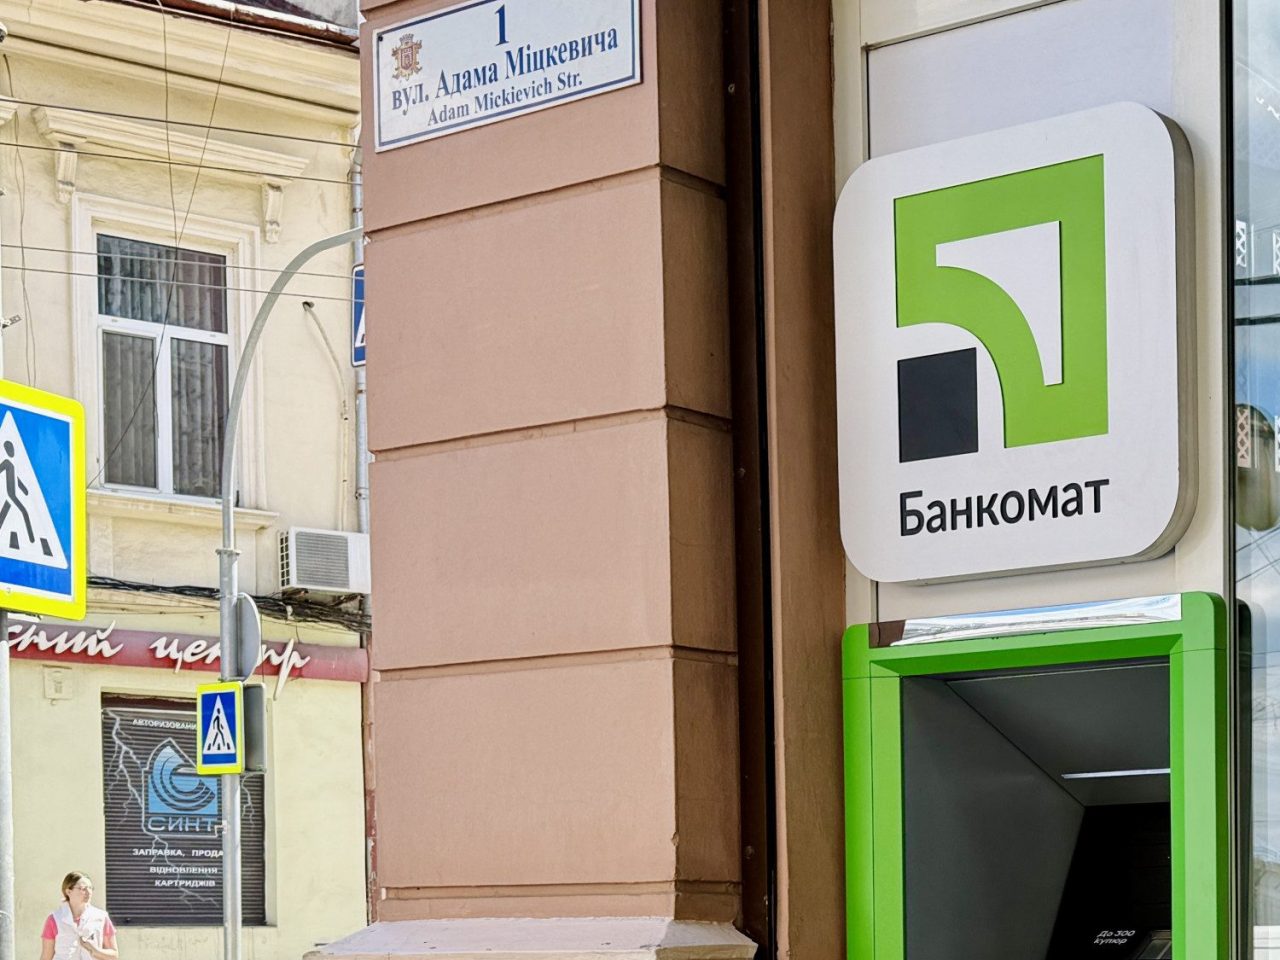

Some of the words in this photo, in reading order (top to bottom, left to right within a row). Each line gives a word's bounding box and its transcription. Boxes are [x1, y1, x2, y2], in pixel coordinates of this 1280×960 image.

[495, 4, 509, 46] 1
[392, 84, 430, 116] вул.
[435, 62, 499, 98] Адама
[505, 27, 618, 80] Міцкевича
[427, 103, 470, 126] Adam
[474, 80, 552, 114] Mickievich
[557, 71, 583, 91] Str.
[900, 479, 1110, 536] Банкомат
[191, 849, 224, 858] ПРОДА
[1094, 937, 1127, 945] купюр
